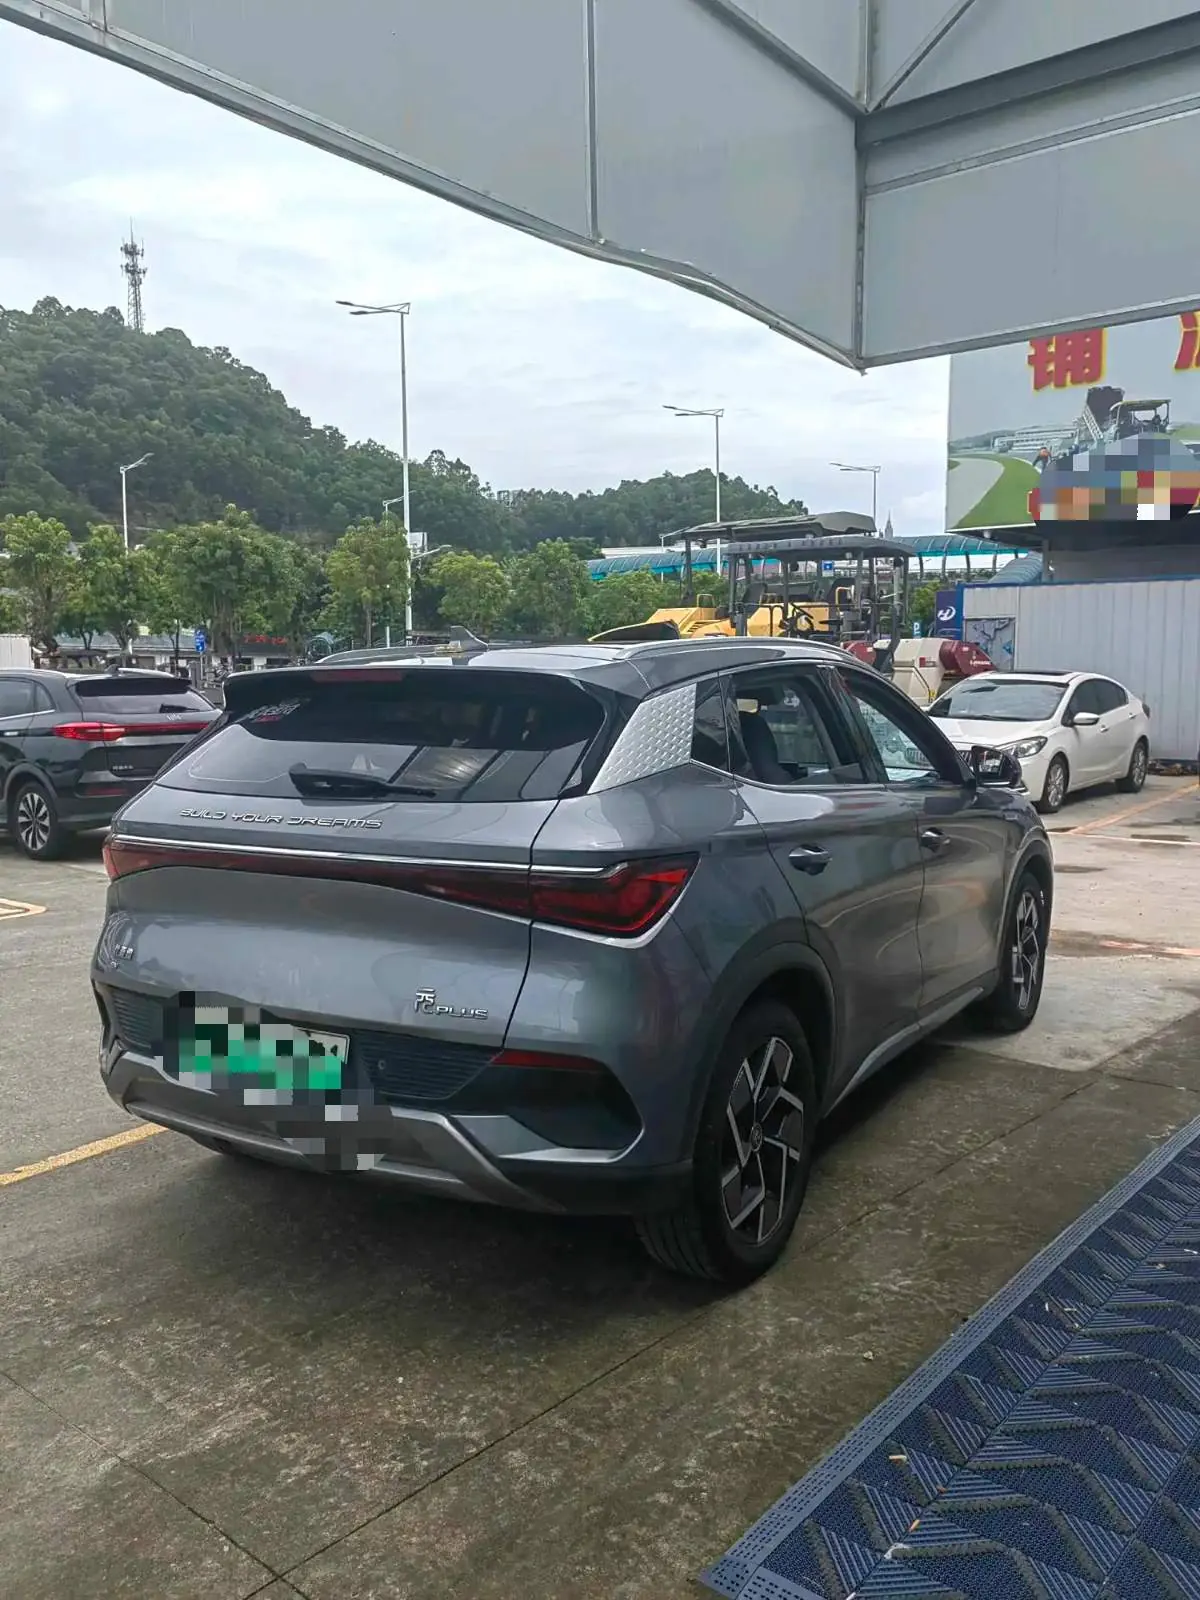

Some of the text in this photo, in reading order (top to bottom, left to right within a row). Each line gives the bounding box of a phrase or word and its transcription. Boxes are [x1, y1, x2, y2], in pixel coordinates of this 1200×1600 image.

[179, 808, 384, 829] BUILD YOUR DREAMS
[436, 1006, 488, 1020] PLUS
